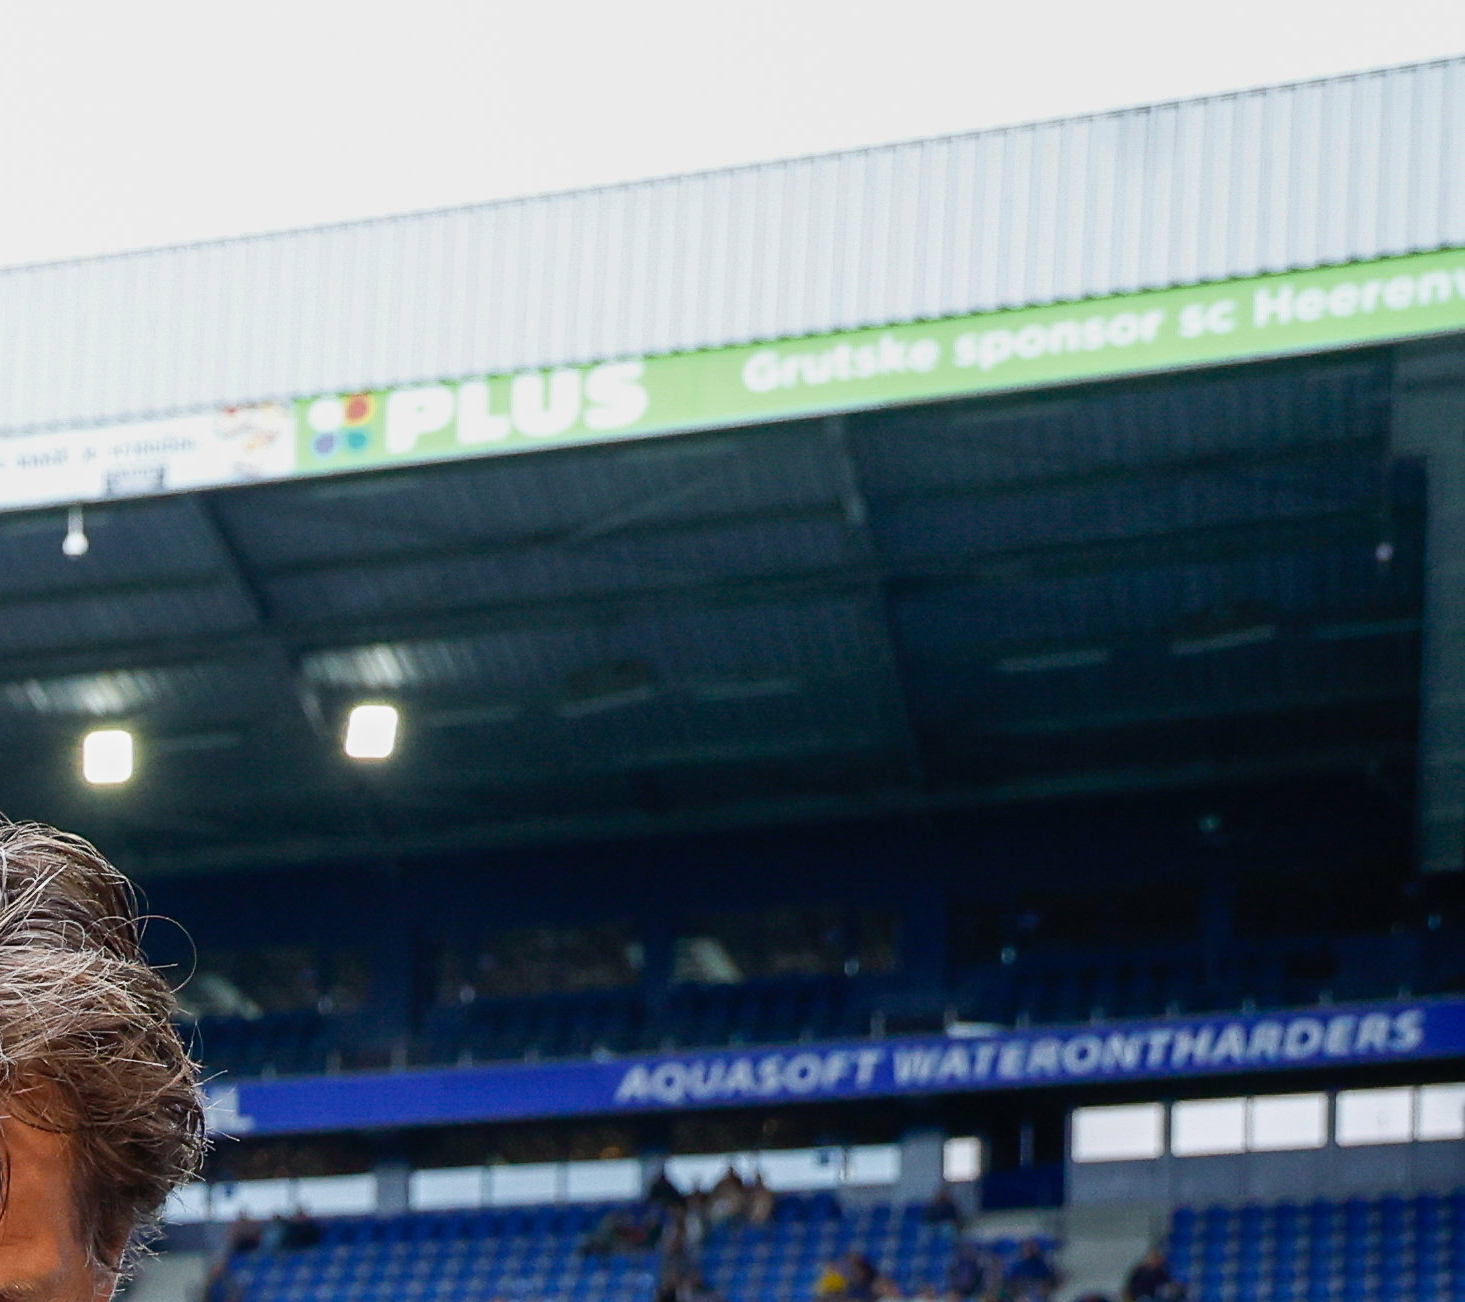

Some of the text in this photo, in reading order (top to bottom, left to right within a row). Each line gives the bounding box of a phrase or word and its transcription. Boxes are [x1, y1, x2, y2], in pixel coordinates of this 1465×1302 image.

[741, 335, 940, 395] Grutske
[953, 306, 1166, 370] sponsor
[1178, 299, 1236, 338] sc
[385, 361, 650, 454] PLUS
[613, 1009, 1427, 1105] AQUASOFT WATERONTHARDERS
